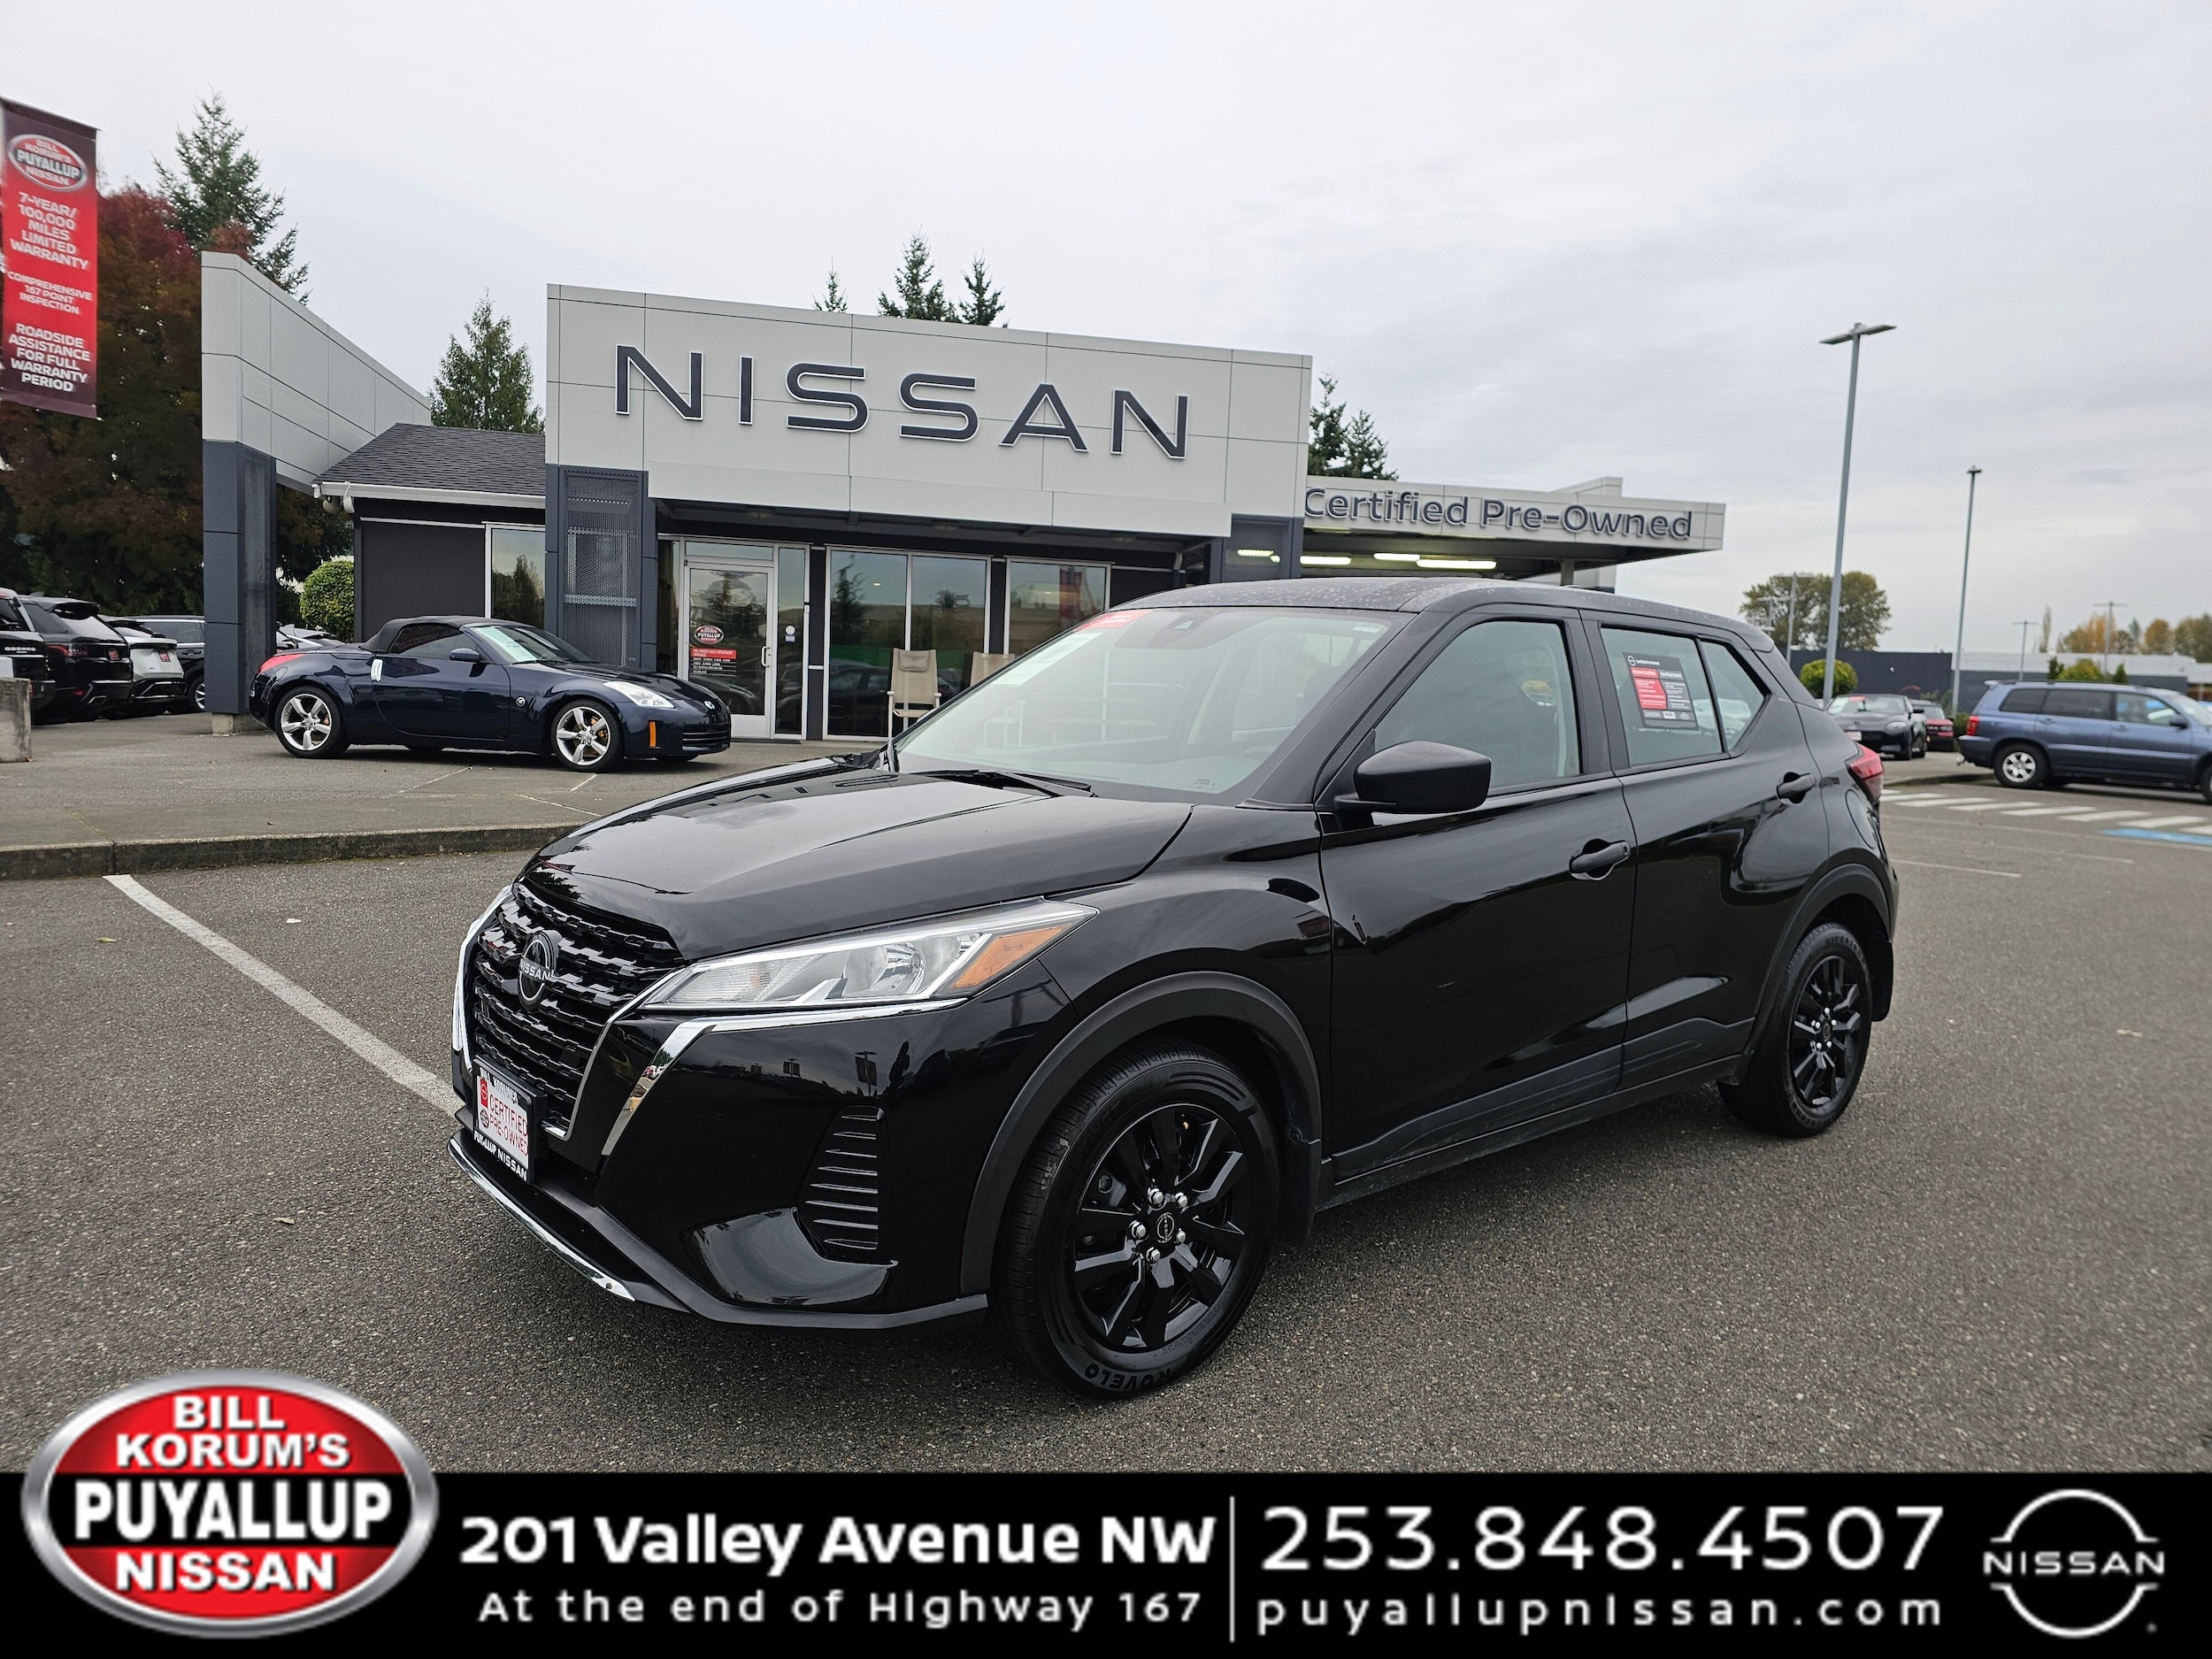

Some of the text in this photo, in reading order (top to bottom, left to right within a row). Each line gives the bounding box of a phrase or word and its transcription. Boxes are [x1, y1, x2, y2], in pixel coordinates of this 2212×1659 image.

[18, 149, 81, 179] PUYALLUP
[25, 165, 69, 186] NISSAN
[18, 204, 76, 231] 100,000
[19, 191, 78, 219] 7-YEAR/
[21, 229, 77, 255] LIMITED
[28, 219, 70, 241] MILES
[10, 238, 88, 270] WARRANTY
[7, 271, 92, 300] COMPREHENSIVE
[25, 284, 74, 304] 167 POINT
[19, 292, 80, 315] INSPECTION
[9, 334, 91, 362] ASSISTANCE
[16, 323, 84, 349] ROADSIDE
[10, 357, 88, 383] WARRANTY
[17, 348, 81, 371] FOR FULL
[21, 373, 74, 392] PERIOD
[616, 345, 1188, 460] NISSAN
[1304, 488, 1694, 541] Certified Pre-Owned
[489, 1094, 528, 1137] CERTIFIED
[489, 1113, 528, 1156] PRE-OWNED
[497, 1148, 528, 1182] NISSAN
